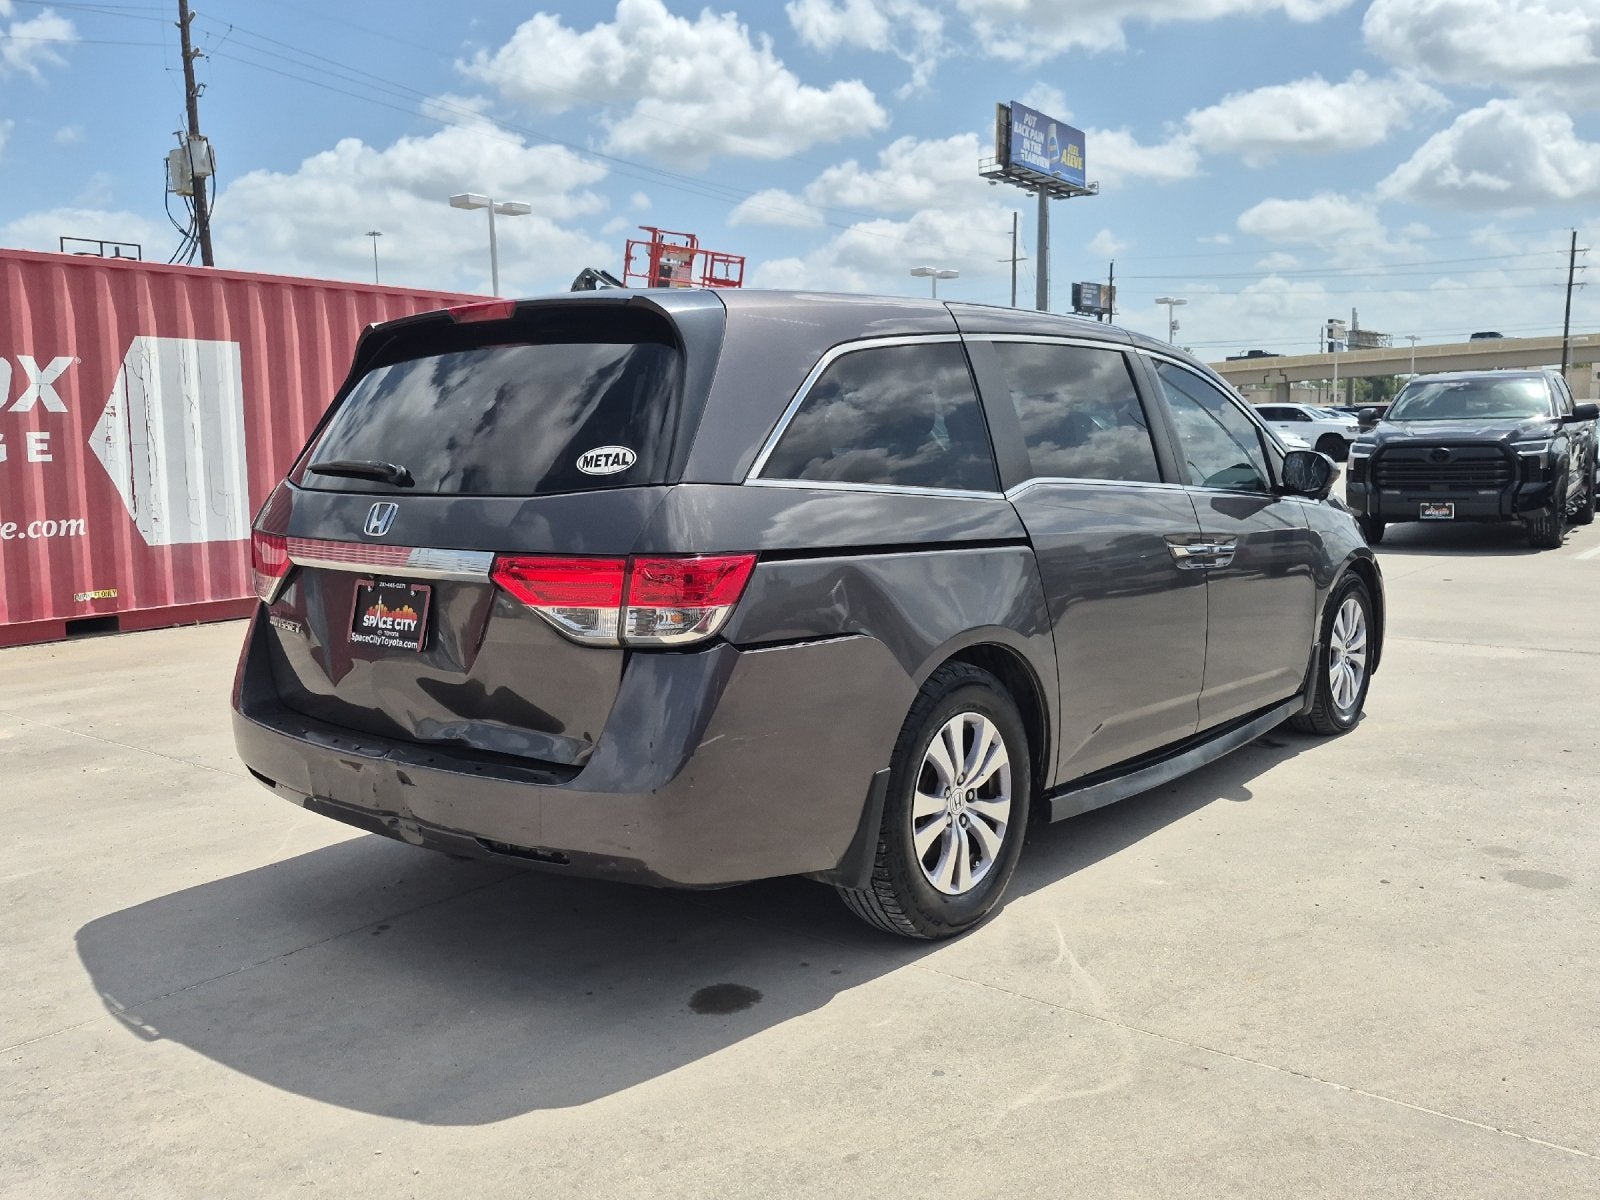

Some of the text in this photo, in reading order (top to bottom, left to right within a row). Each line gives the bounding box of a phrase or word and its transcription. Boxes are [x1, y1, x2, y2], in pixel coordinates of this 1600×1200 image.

[0, 432, 52, 462] E
[582, 452, 630, 468] METAL
[0, 518, 86, 539] e.com
[363, 614, 417, 631] SPACE CITY
[351, 632, 418, 649] SpaceCityToyota.com
